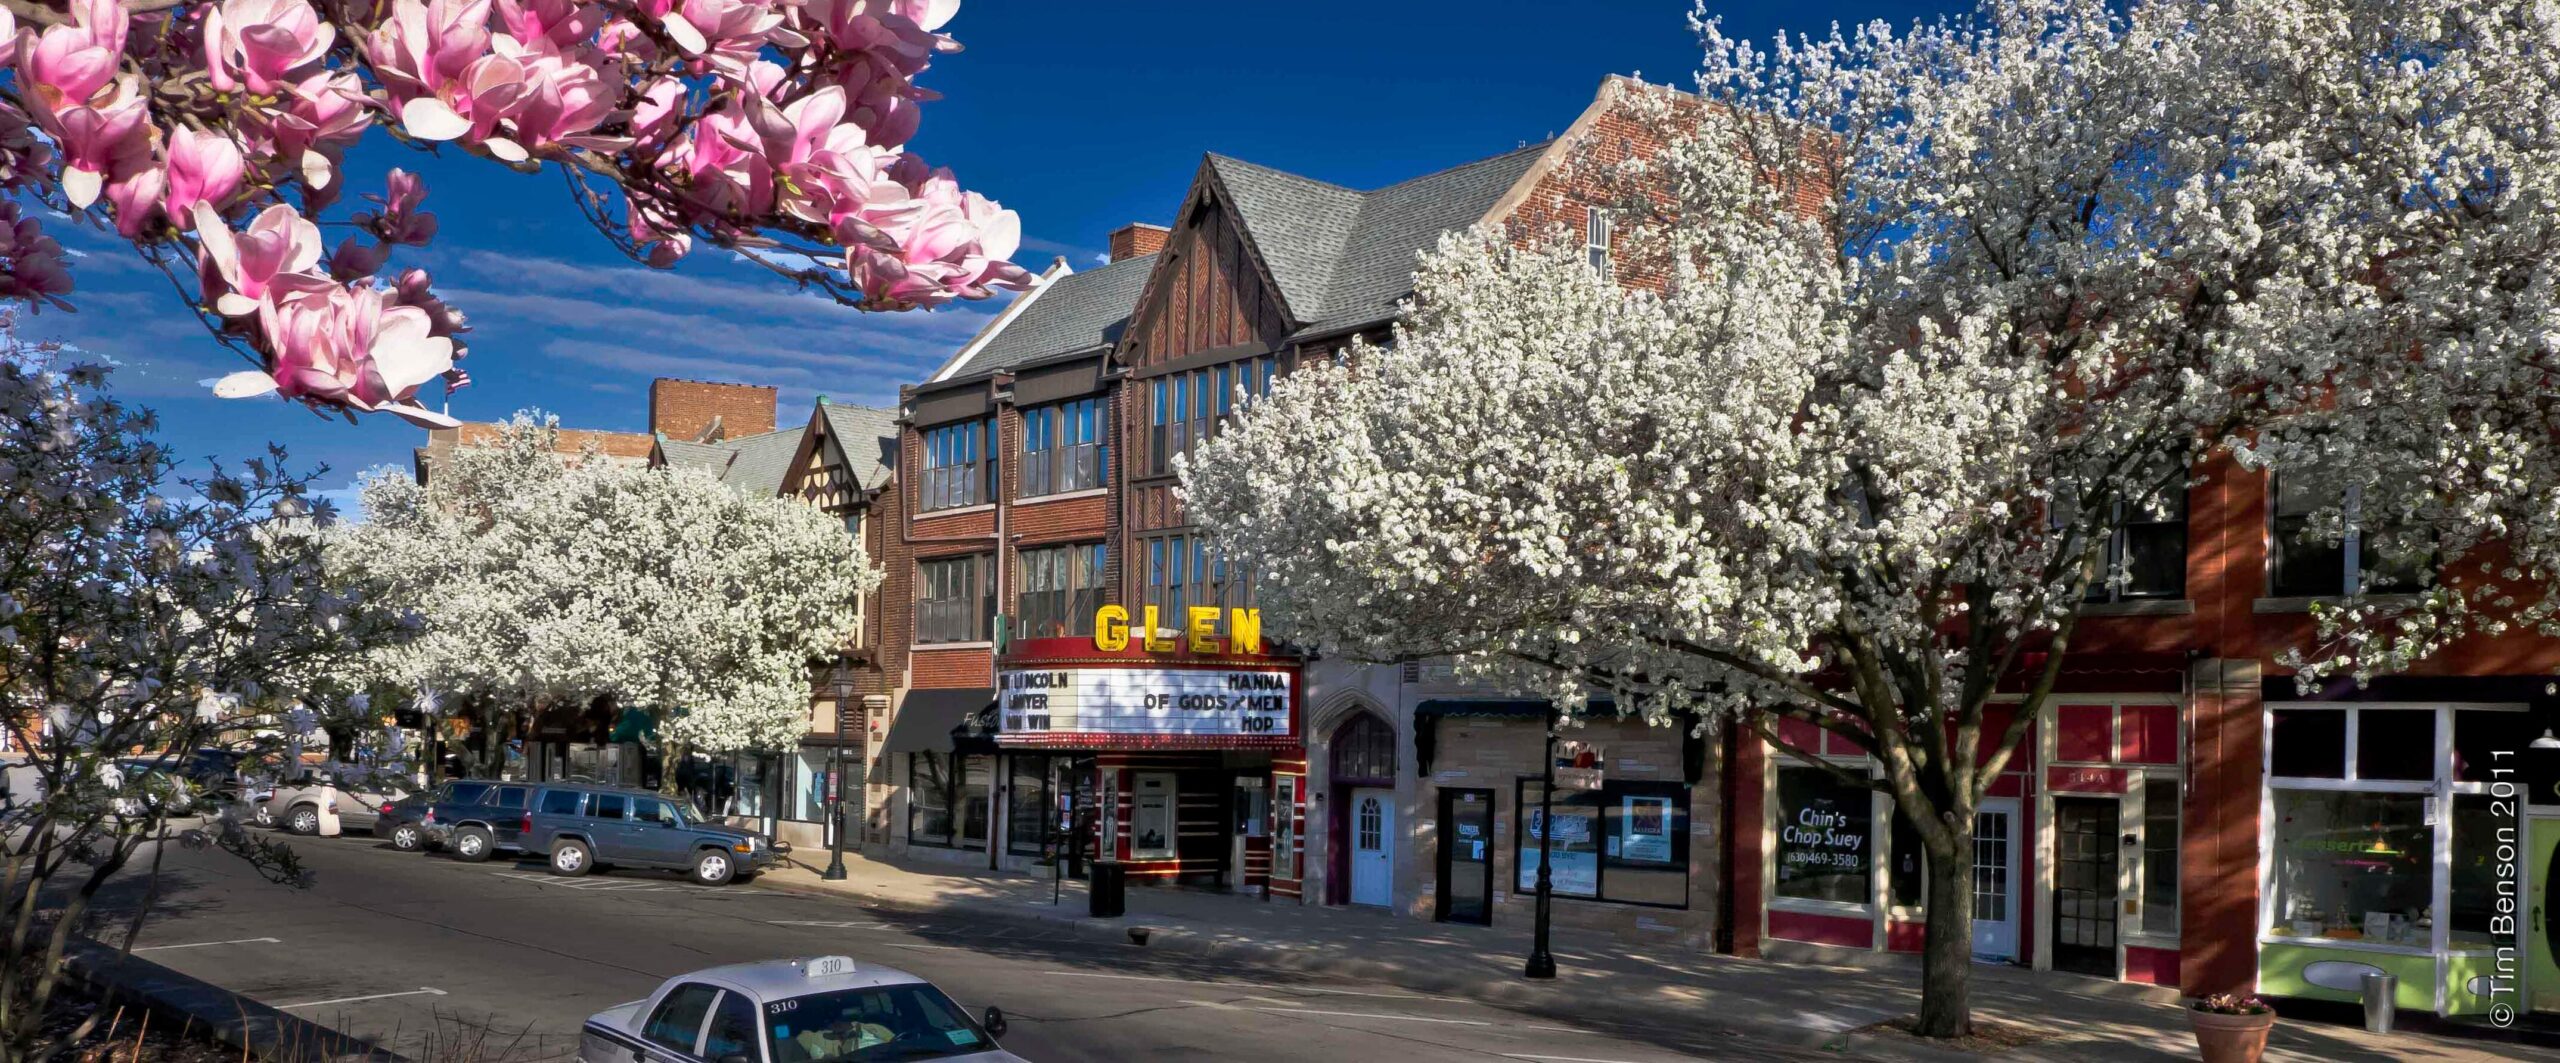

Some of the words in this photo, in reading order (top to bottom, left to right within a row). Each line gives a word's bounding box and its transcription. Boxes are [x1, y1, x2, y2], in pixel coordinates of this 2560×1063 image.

[1095, 604, 1262, 655] GLEN
[1014, 672, 1068, 689] LINCOLN
[1228, 673, 1285, 690] HANNA
[1008, 694, 1048, 710] LAWYER
[1143, 693, 1170, 710] OF
[1178, 694, 1228, 711] GODS
[1247, 695, 1283, 712] MEN
[1027, 714, 1051, 730] WIN
[1241, 716, 1274, 732] HOP
[1799, 807, 1847, 827] Chin's
[1783, 826, 1822, 848] Chop
[1825, 828, 1863, 850] Suey
[1787, 852, 1859, 867] (630)469-3580
[821, 958, 842, 974] 310
[770, 1000, 798, 1014] 310
